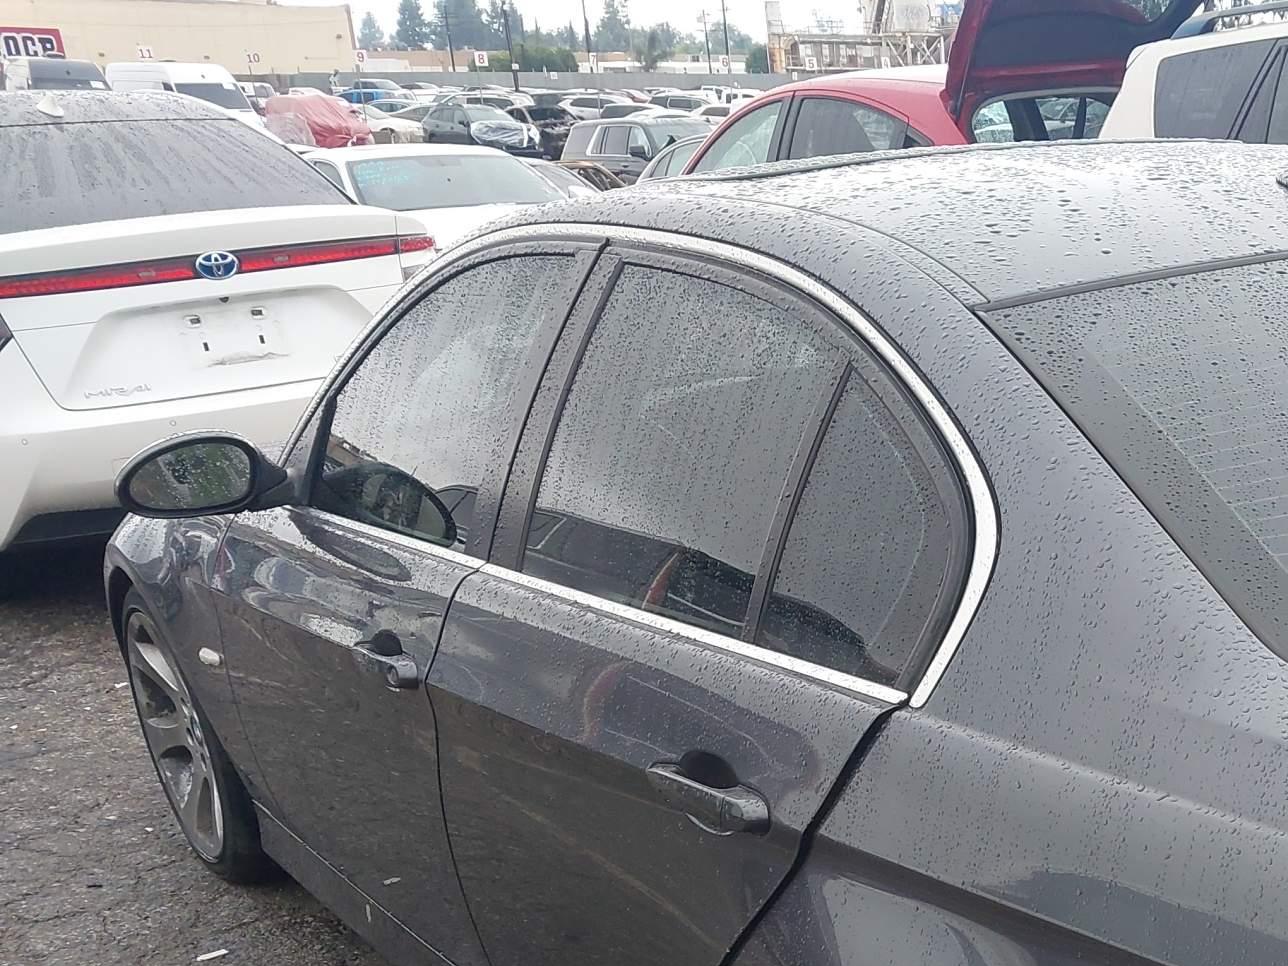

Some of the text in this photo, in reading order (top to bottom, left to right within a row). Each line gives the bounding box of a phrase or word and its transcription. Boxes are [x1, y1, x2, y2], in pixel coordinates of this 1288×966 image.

[138, 48, 153, 59] 11
[246, 53, 260, 64] 10
[477, 53, 485, 65] 8
[808, 58, 815, 69] 5
